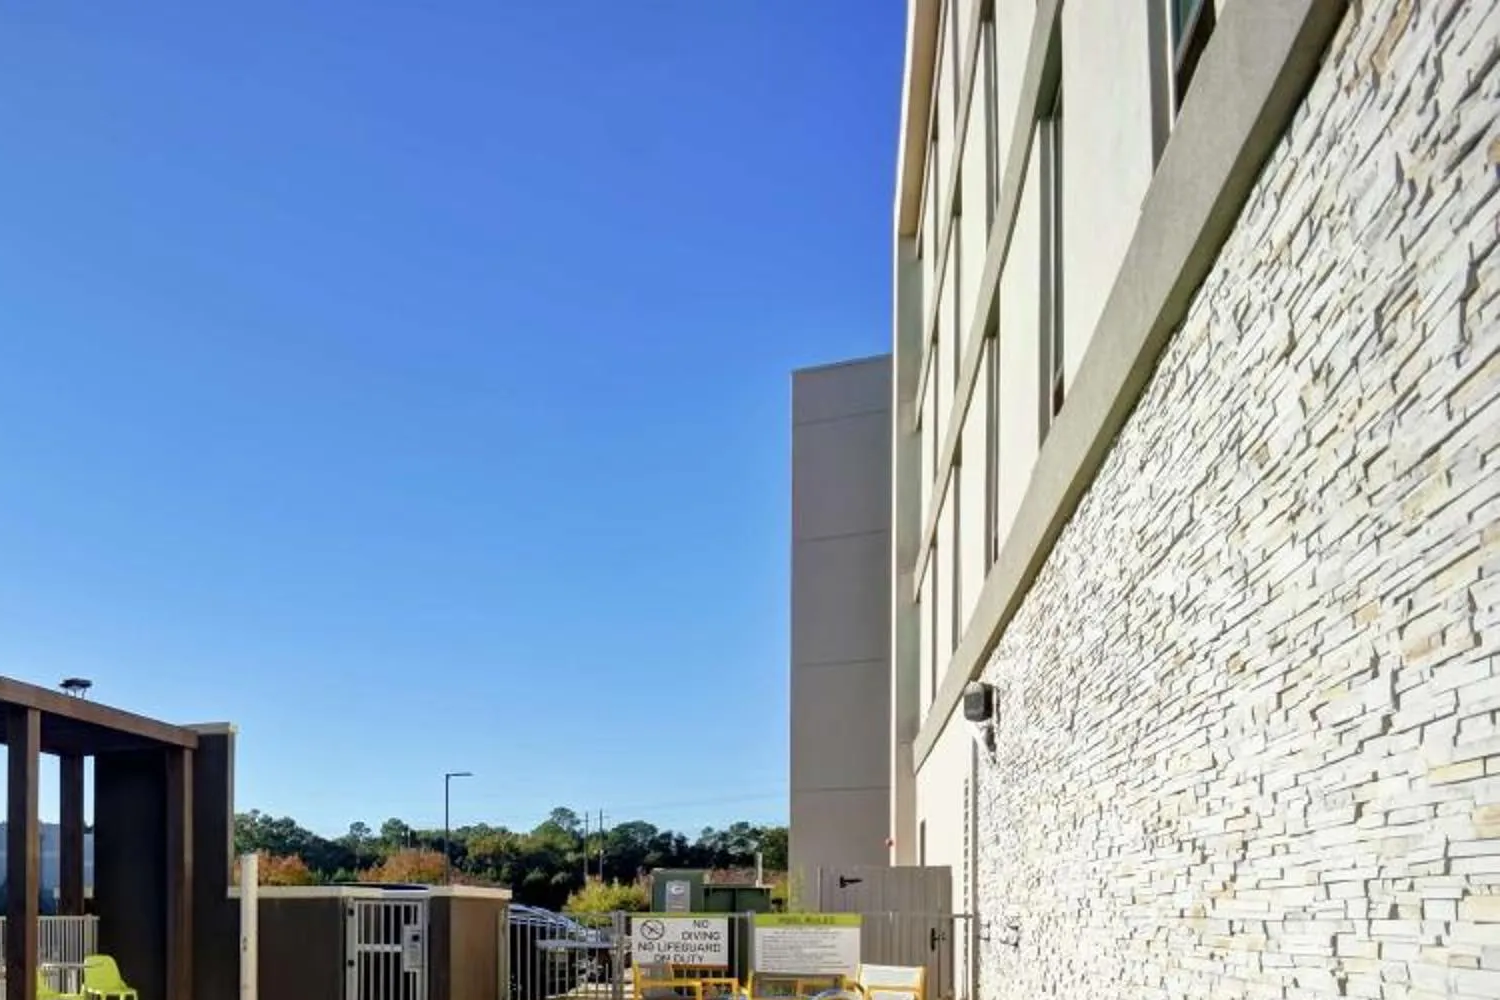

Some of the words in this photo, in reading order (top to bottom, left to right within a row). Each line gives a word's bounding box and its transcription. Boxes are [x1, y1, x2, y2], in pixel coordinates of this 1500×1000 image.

[693, 919, 709, 929] NO
[681, 931, 722, 941] DIVING
[638, 942, 654, 952] NO
[657, 942, 722, 953] LIFEGUARD
[654, 954, 671, 964] ON
[673, 954, 705, 964] DUTY
